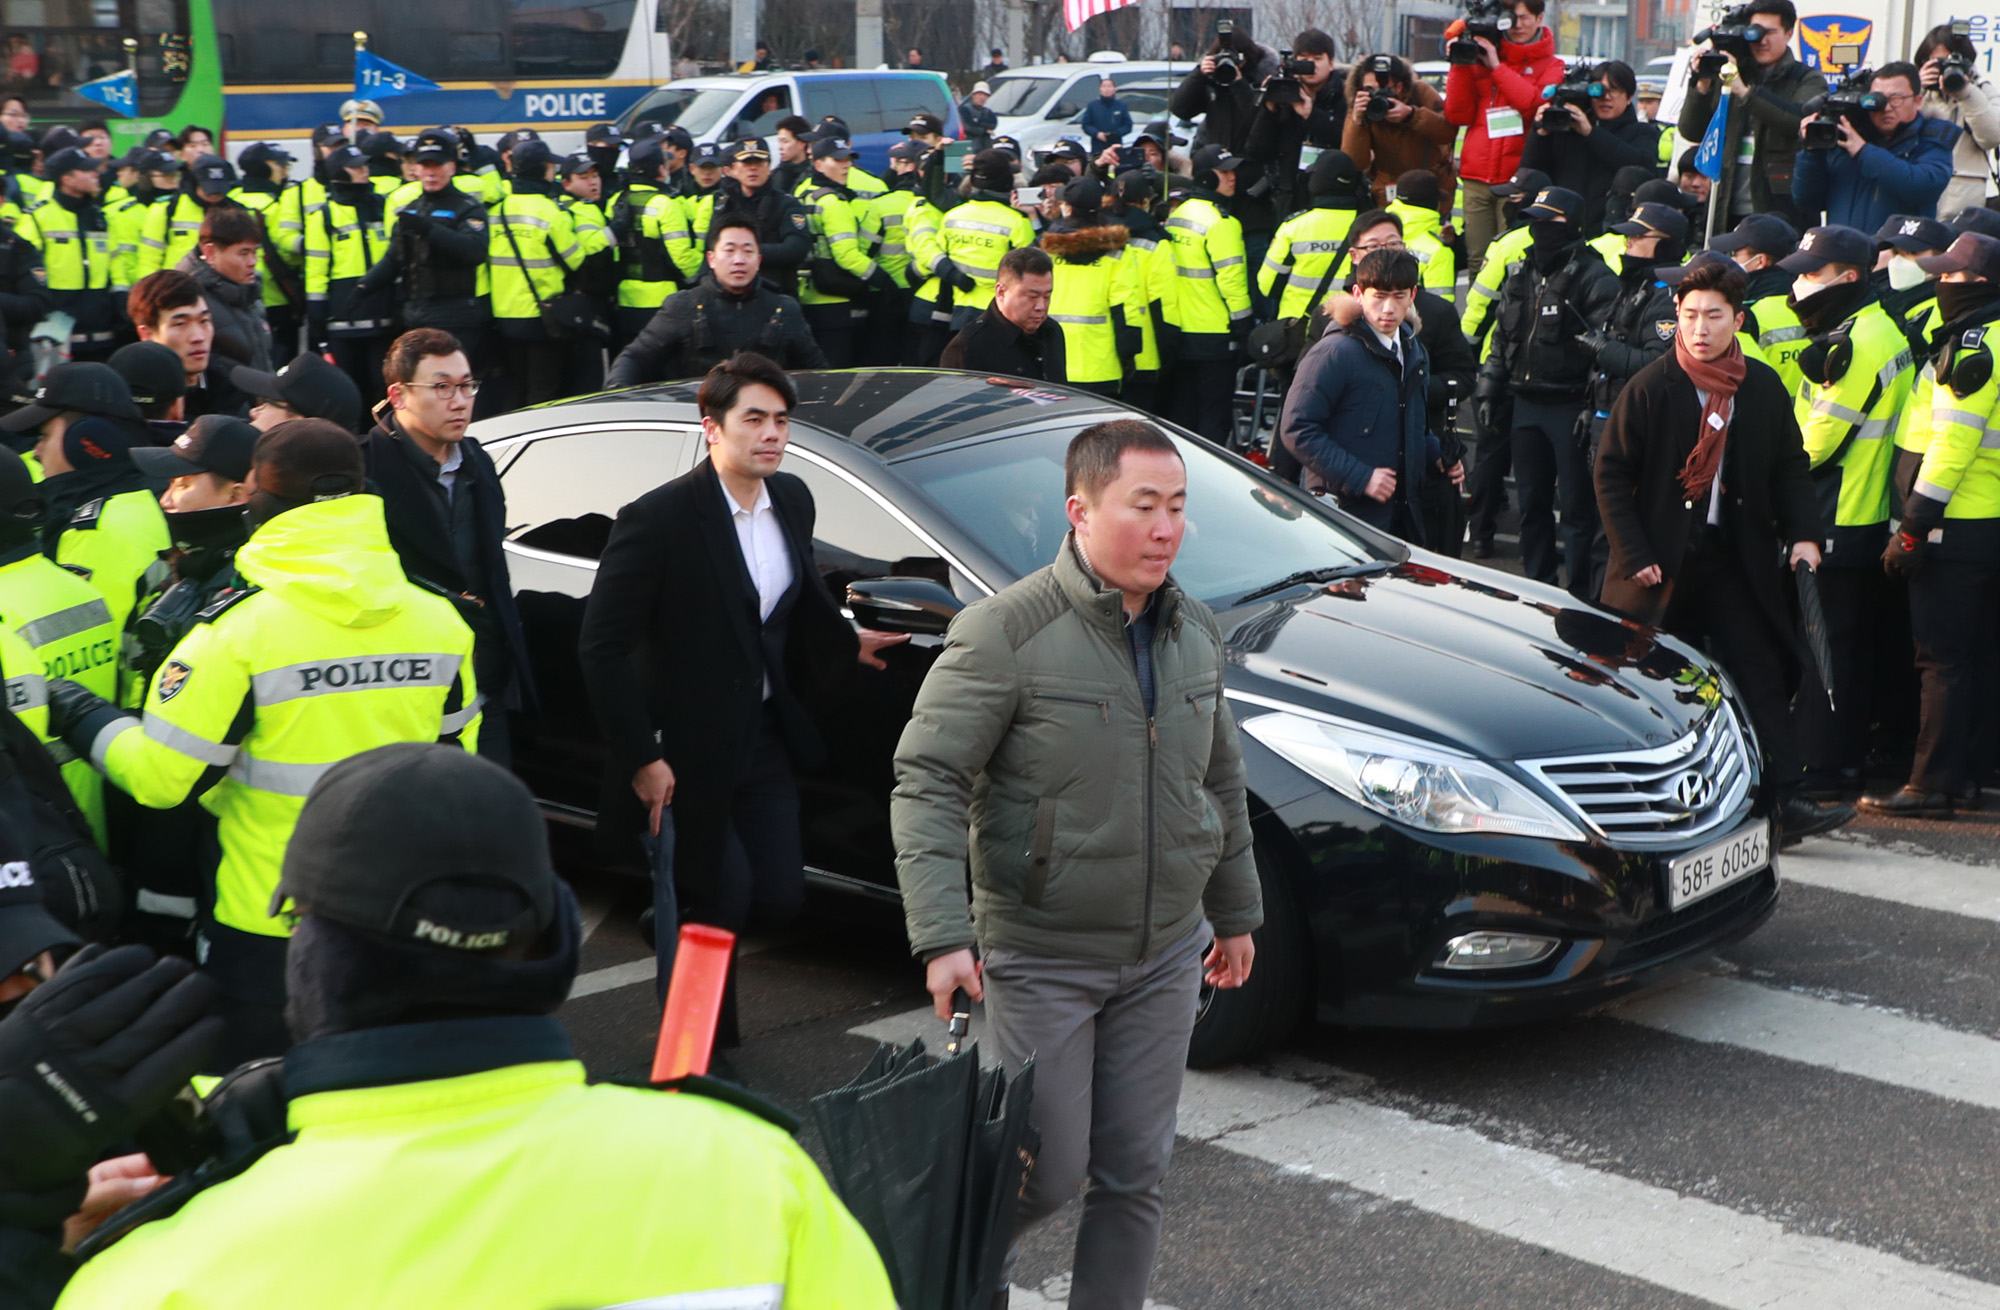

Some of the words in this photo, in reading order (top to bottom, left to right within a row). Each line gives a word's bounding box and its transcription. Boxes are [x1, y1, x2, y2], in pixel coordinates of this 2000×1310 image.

[361, 69, 406, 90] 11-3
[525, 92, 607, 117] POLICE
[297, 659, 432, 691] POLICE
[1682, 856, 1713, 896] 58두
[1721, 832, 1760, 878] 6056
[414, 919, 509, 949] POLICE
